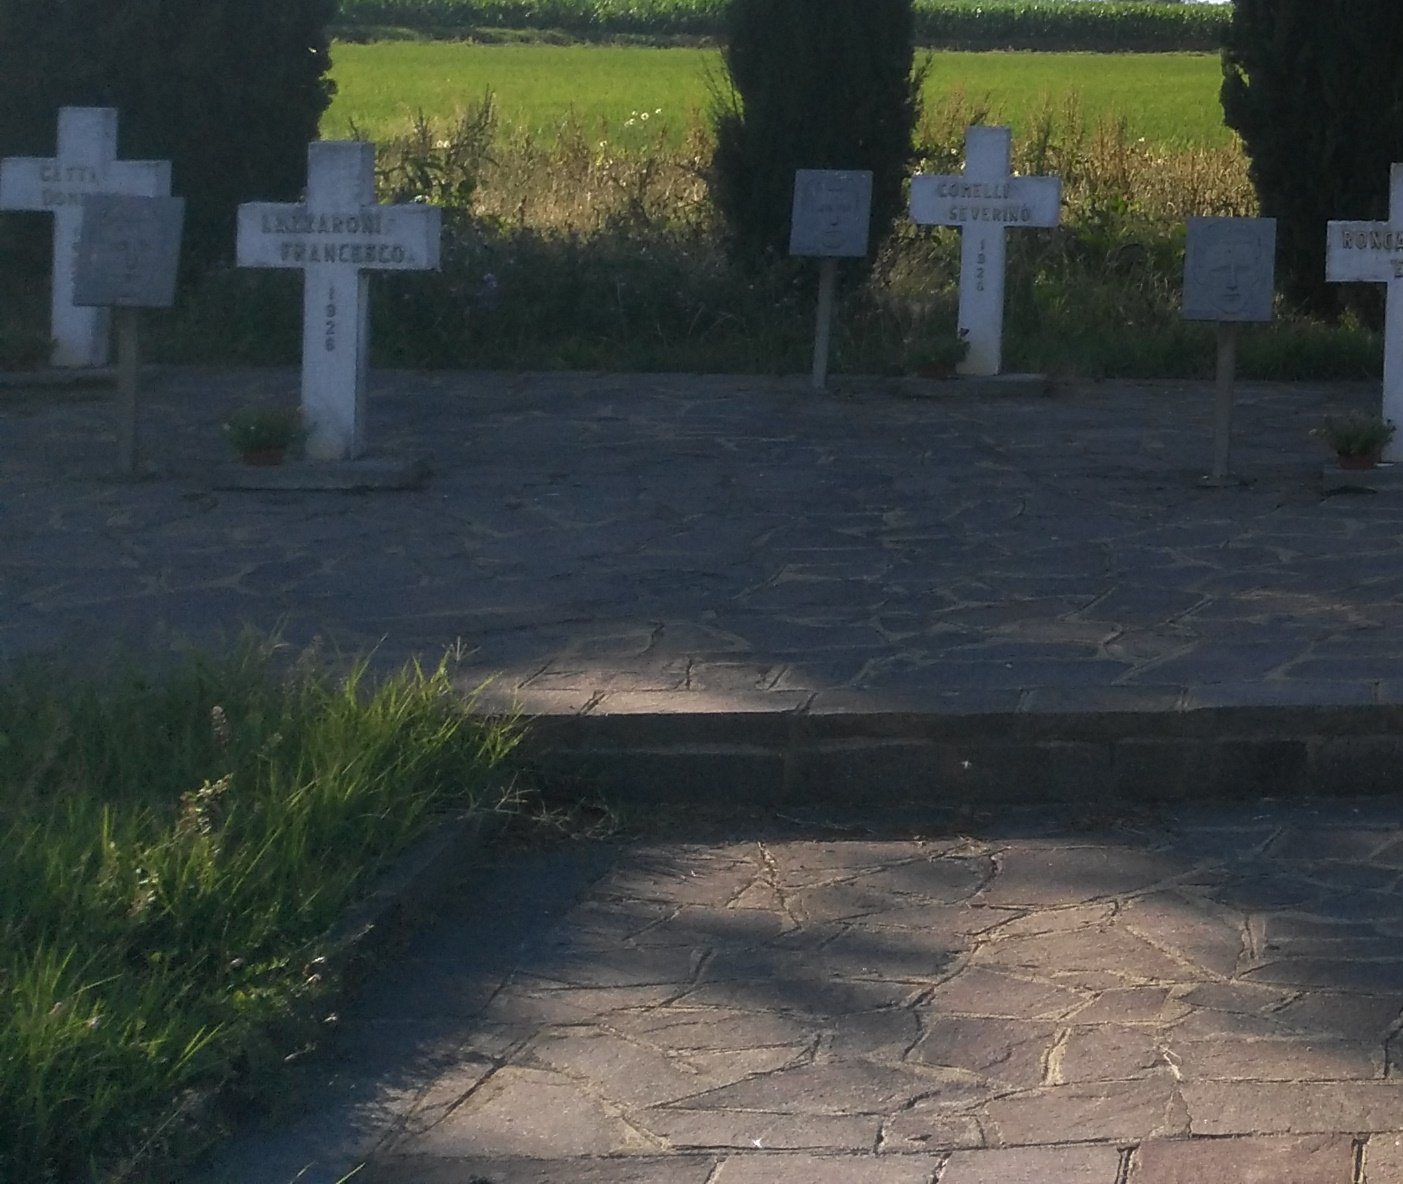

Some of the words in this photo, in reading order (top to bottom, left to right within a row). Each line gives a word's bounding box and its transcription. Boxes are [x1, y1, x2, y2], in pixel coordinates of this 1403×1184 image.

[261, 212, 382, 234] LAZZARONI
[948, 206, 1032, 222] SEVERINO
[280, 242, 406, 264] FRANCESCO
[324, 285, 337, 352] 1926
